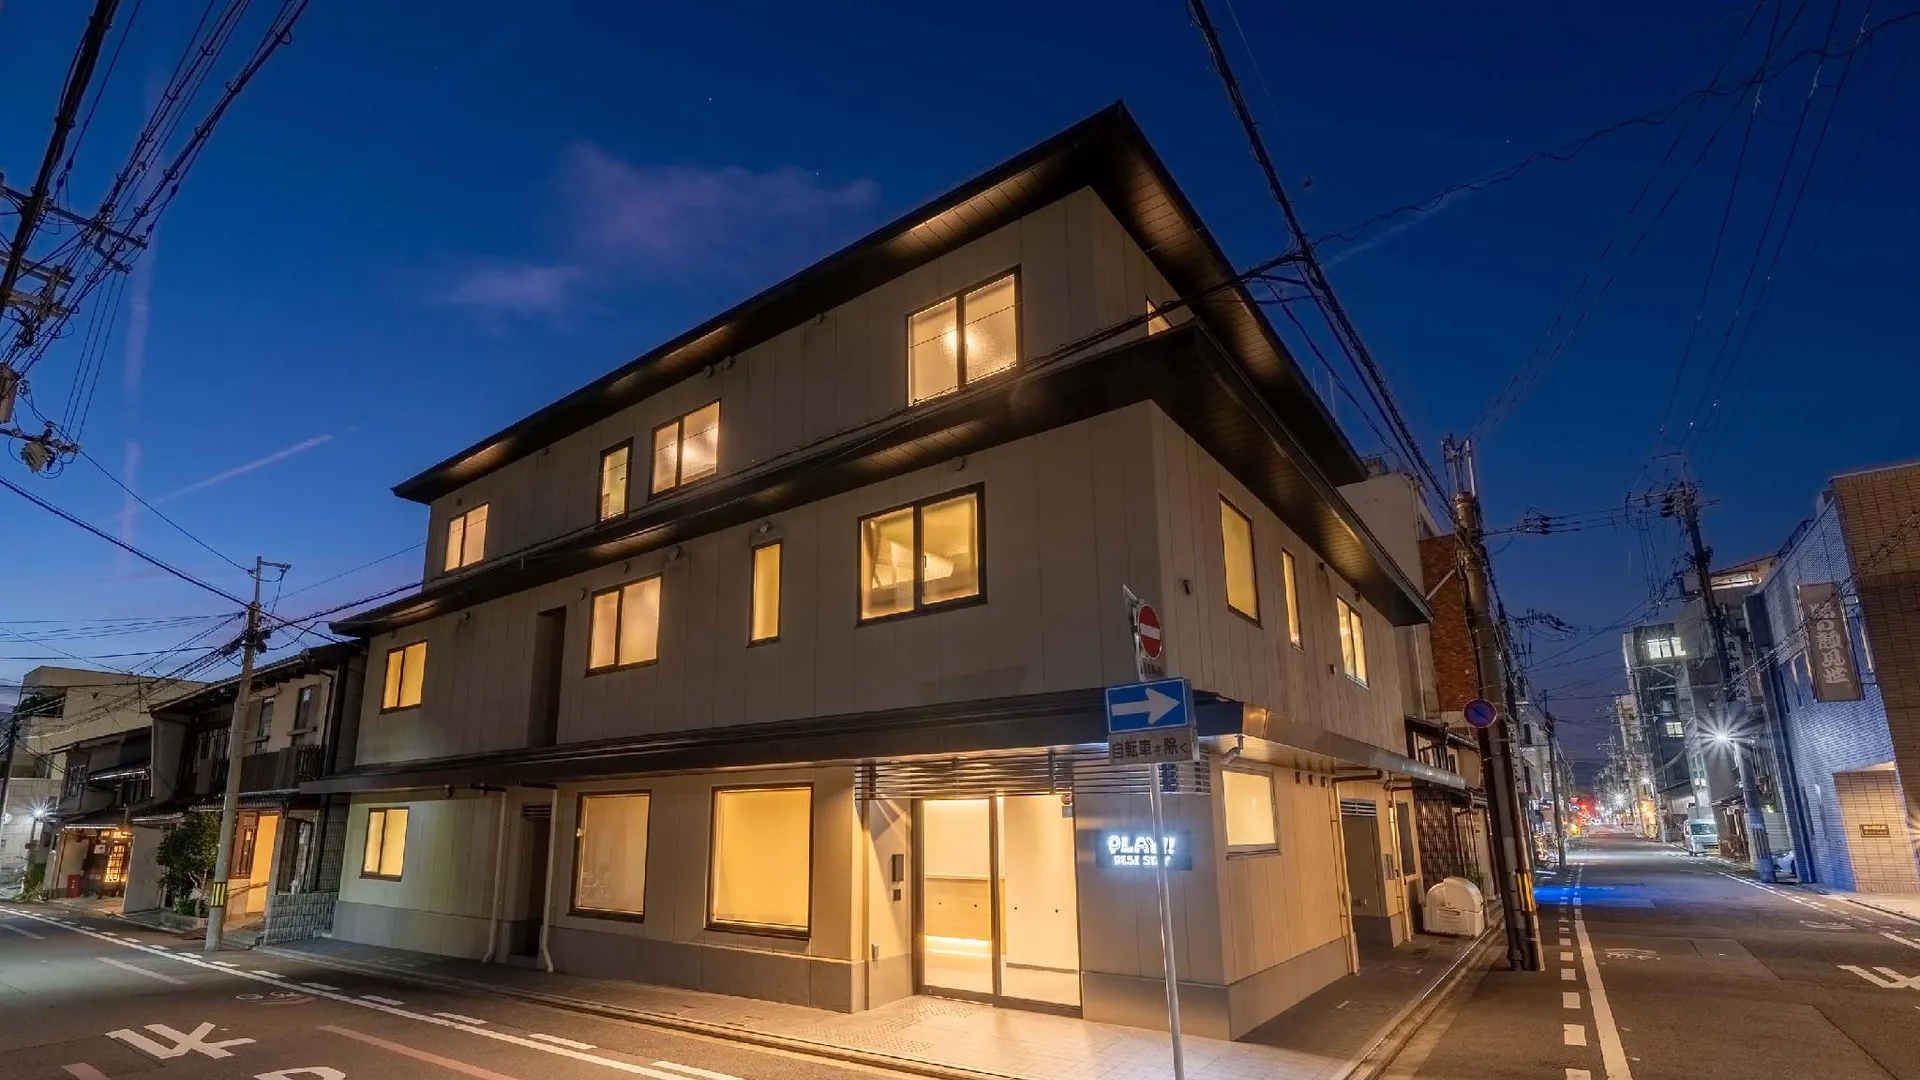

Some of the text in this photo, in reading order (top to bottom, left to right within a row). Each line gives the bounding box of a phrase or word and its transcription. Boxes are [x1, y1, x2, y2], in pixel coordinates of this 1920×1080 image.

[1112, 737, 1188, 759] 自転車を除く
[1142, 855, 1172, 867] STY
